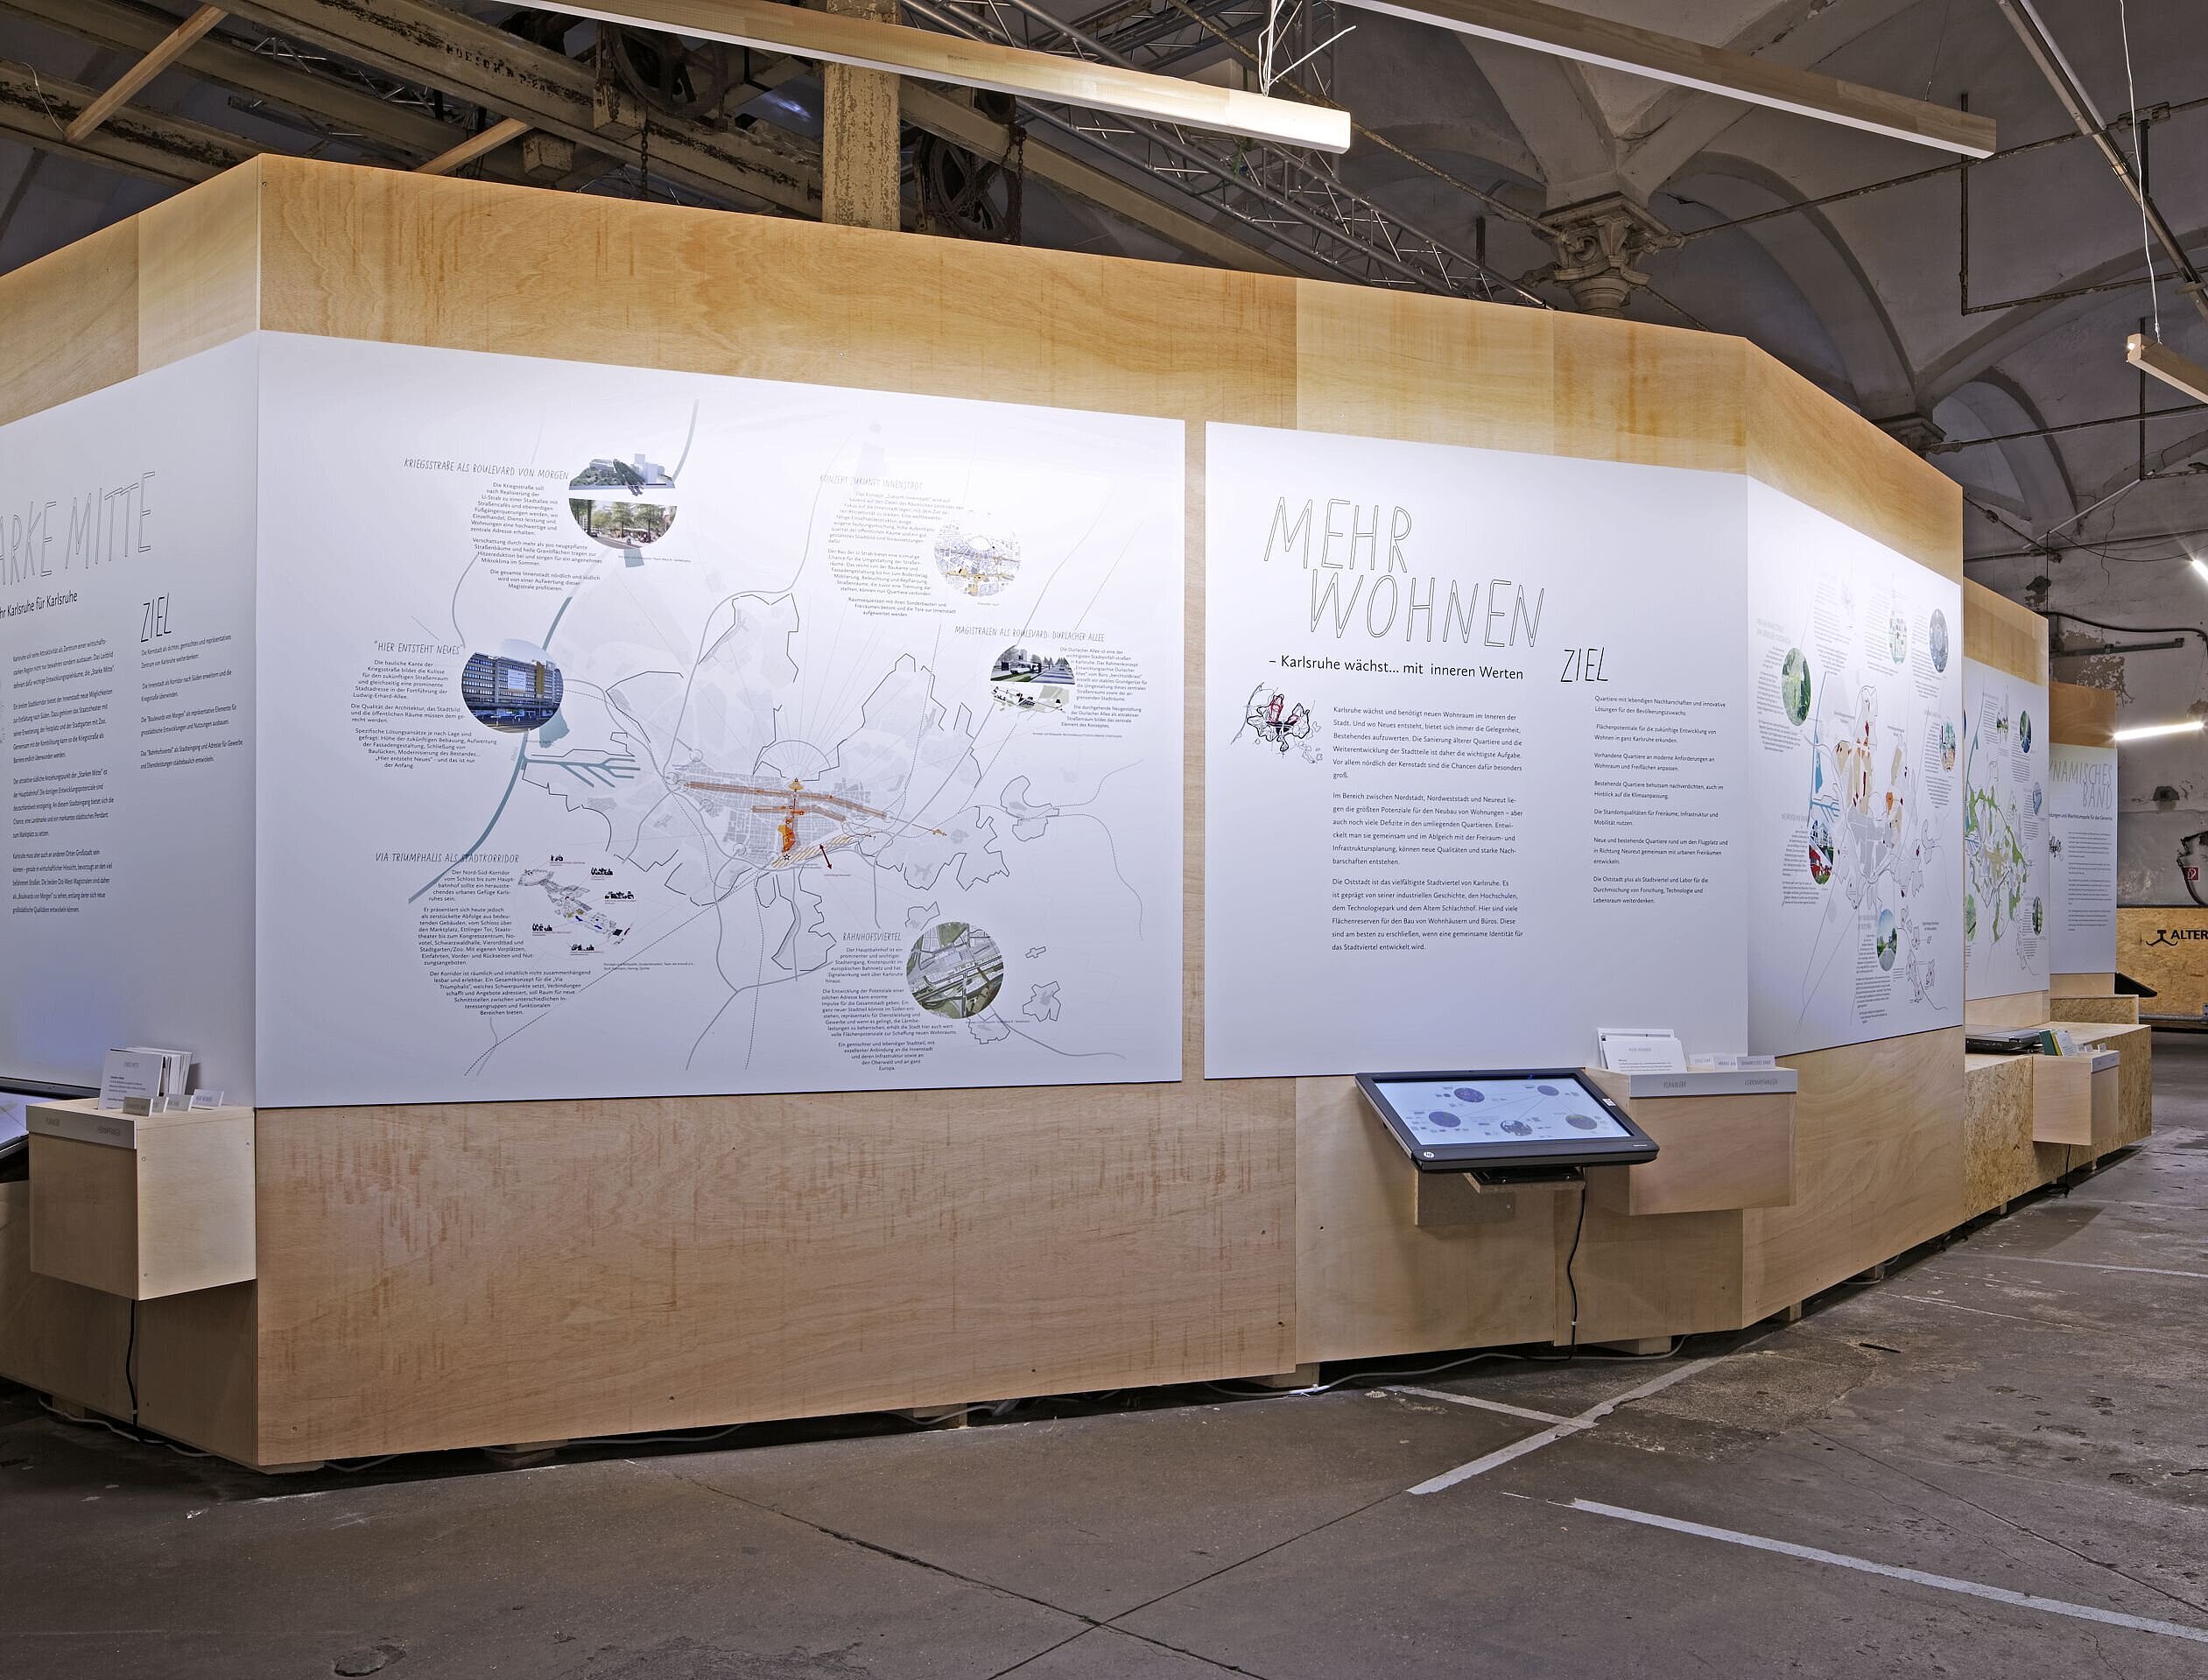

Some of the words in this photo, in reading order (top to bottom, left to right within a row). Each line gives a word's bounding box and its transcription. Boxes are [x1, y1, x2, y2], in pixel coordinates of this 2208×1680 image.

[456, 462, 470, 473] ALS
[473, 463, 516, 476] BOULEVARD
[518, 467, 535, 477] VON
[537, 468, 569, 481] MORGEN
[65, 471, 156, 569] MITTE
[1263, 496, 1412, 573] MEHR
[7, 599, 35, 618] Karlsruhe
[35, 596, 46, 611] für
[46, 590, 78, 608] Karlsruhe
[1311, 568, 1544, 648] WOHNEN
[140, 592, 172, 643] ZIEL
[954, 625, 996, 636] MAGISTRALEN
[999, 627, 1011, 637] ALS
[1051, 629, 1086, 641] DURLACHER
[1087, 632, 1106, 643] ALLEE
[397, 642, 434, 654] ENTSTEHT
[1282, 656, 1340, 670] Karlsruhe
[1345, 659, 1399, 672] wächst...
[1403, 663, 1424, 674] mit
[1431, 664, 1475, 677] inneren
[1480, 666, 1523, 679] Werten
[1560, 647, 1609, 683] ZIEL
[1398, 709, 1423, 718] benötigt
[1333, 746, 1389, 755] Weiterentwicklung
[2083, 782, 2113, 810] BAND
[375, 853, 389, 862] VIA
[392, 852, 442, 862] TRIUMPHALIS
[444, 853, 458, 863] ALS
[461, 853, 519, 863] STADTKORRIDOR
[842, 931, 902, 942] BAHNHOFSVIERTEL
[2170, 930, 2208, 940] ALTER
